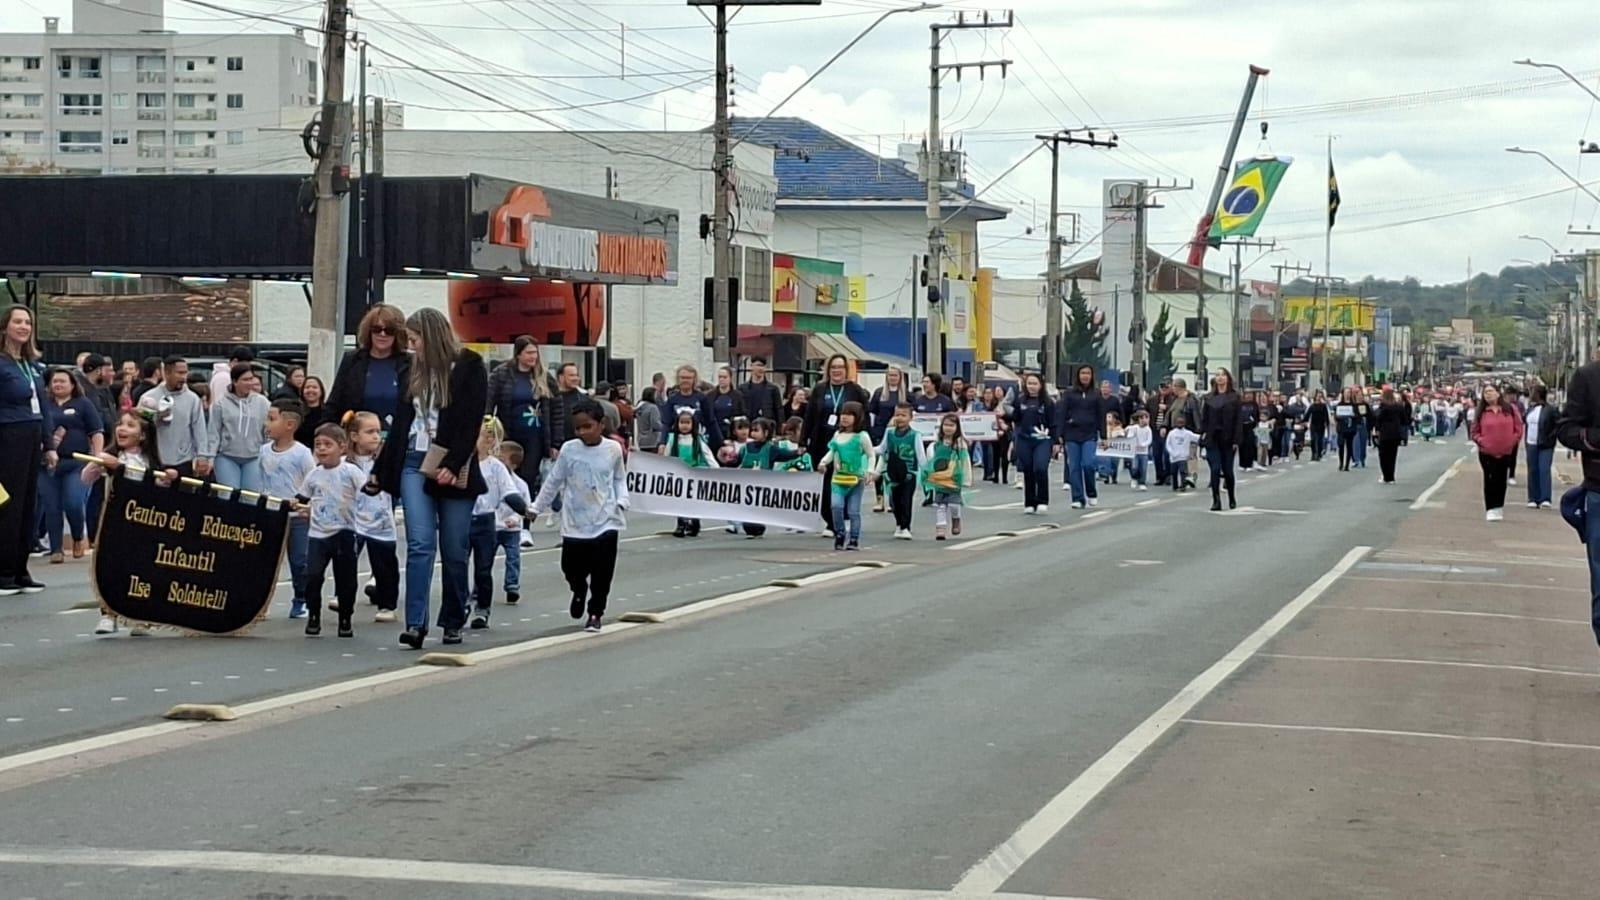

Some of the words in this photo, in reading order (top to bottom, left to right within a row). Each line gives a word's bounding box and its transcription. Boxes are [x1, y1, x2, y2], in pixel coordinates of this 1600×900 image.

[599, 232, 667, 278] MULTIMARCAS
[626, 471, 647, 493] CEI
[649, 472, 683, 497] JOÃO
[686, 479, 694, 499] E
[697, 480, 741, 505] MARIA
[125, 499, 167, 528] Centro
[169, 510, 186, 532] de
[200, 515, 263, 549] Educação
[154, 543, 216, 573] Infantil
[128, 575, 151, 598] Ilse
[167, 581, 228, 610] Soldatelli
